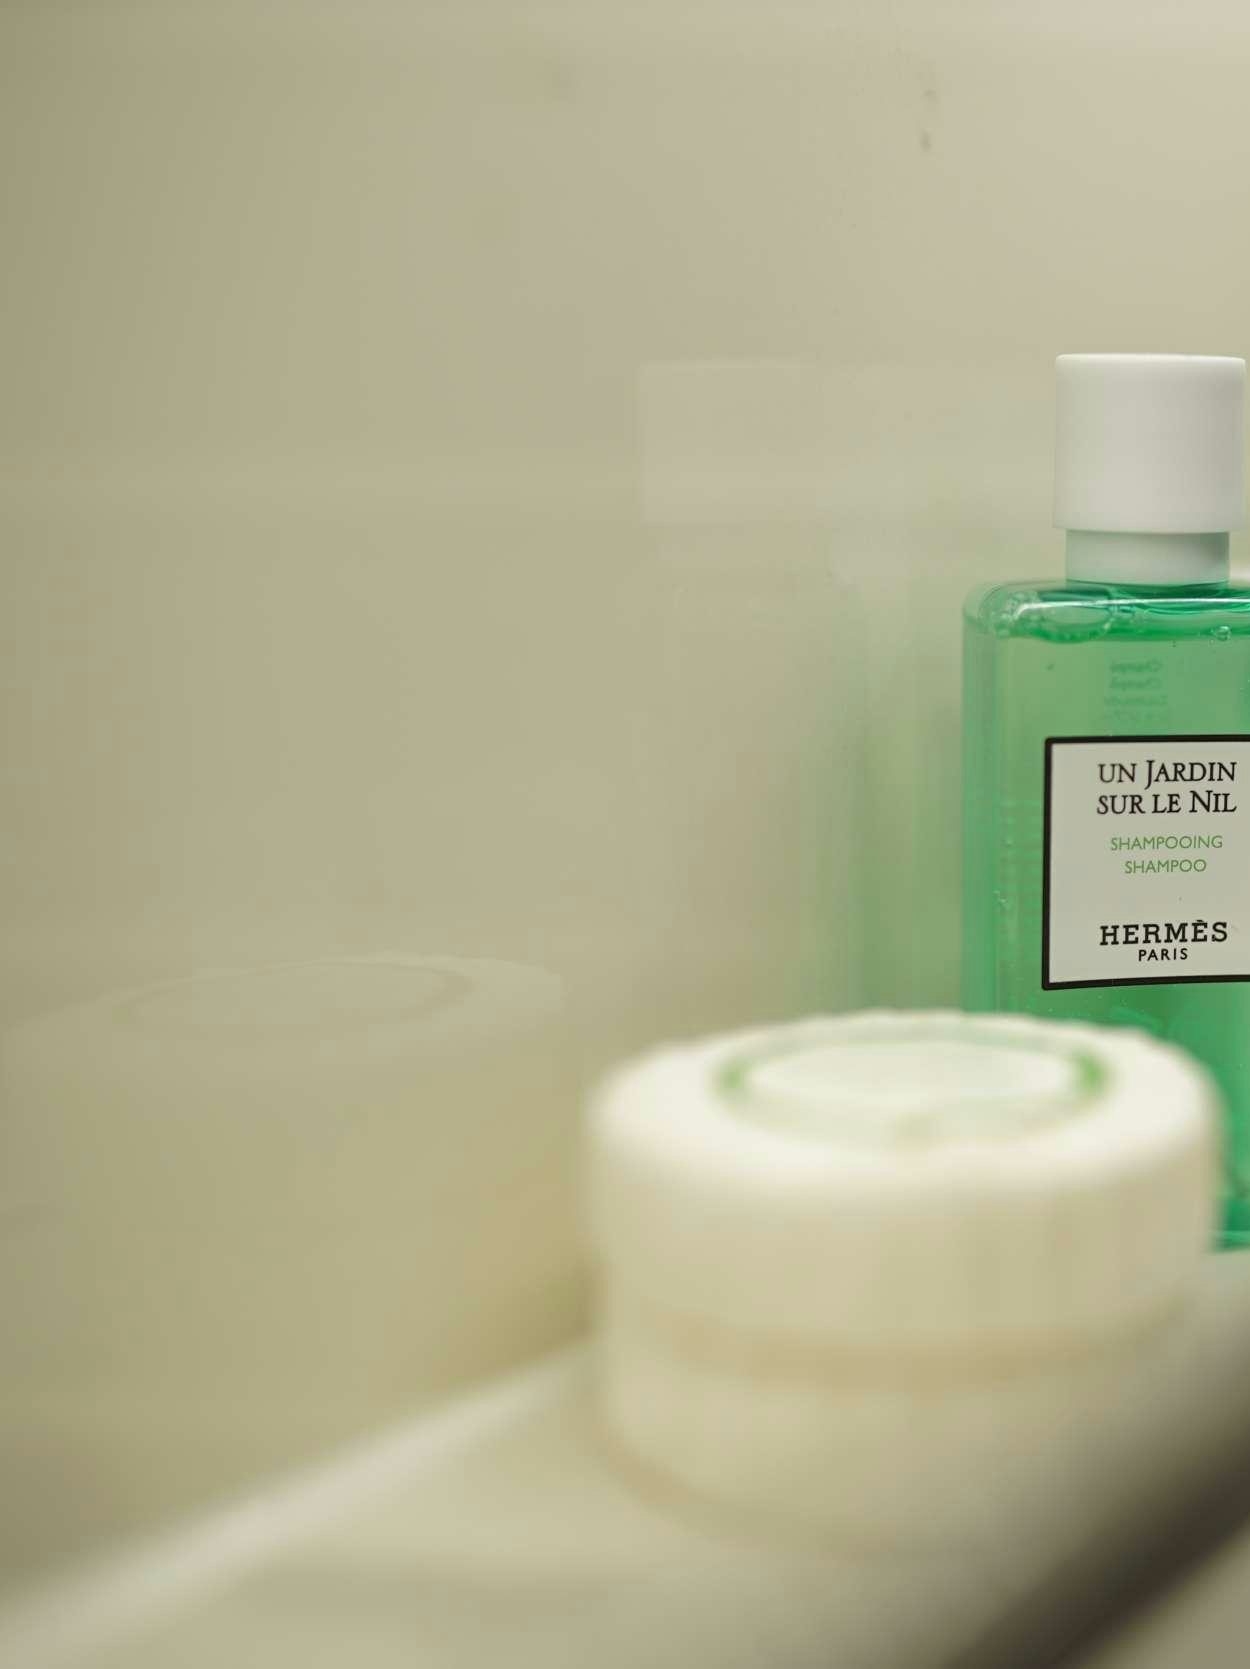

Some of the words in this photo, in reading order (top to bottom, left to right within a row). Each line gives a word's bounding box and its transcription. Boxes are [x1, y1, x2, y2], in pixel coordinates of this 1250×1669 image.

[1097, 762, 1138, 784] UN
[1143, 759, 1238, 791] JARDIN
[1096, 794, 1147, 815] SUR
[1151, 793, 1182, 814] LE
[1188, 789, 1238, 814] NIL
[1110, 835, 1224, 851] SHAMPOOING
[1124, 858, 1207, 874] SHAMPOO
[1098, 919, 1229, 947] HERMÈS
[1138, 947, 1189, 962] PARIS
